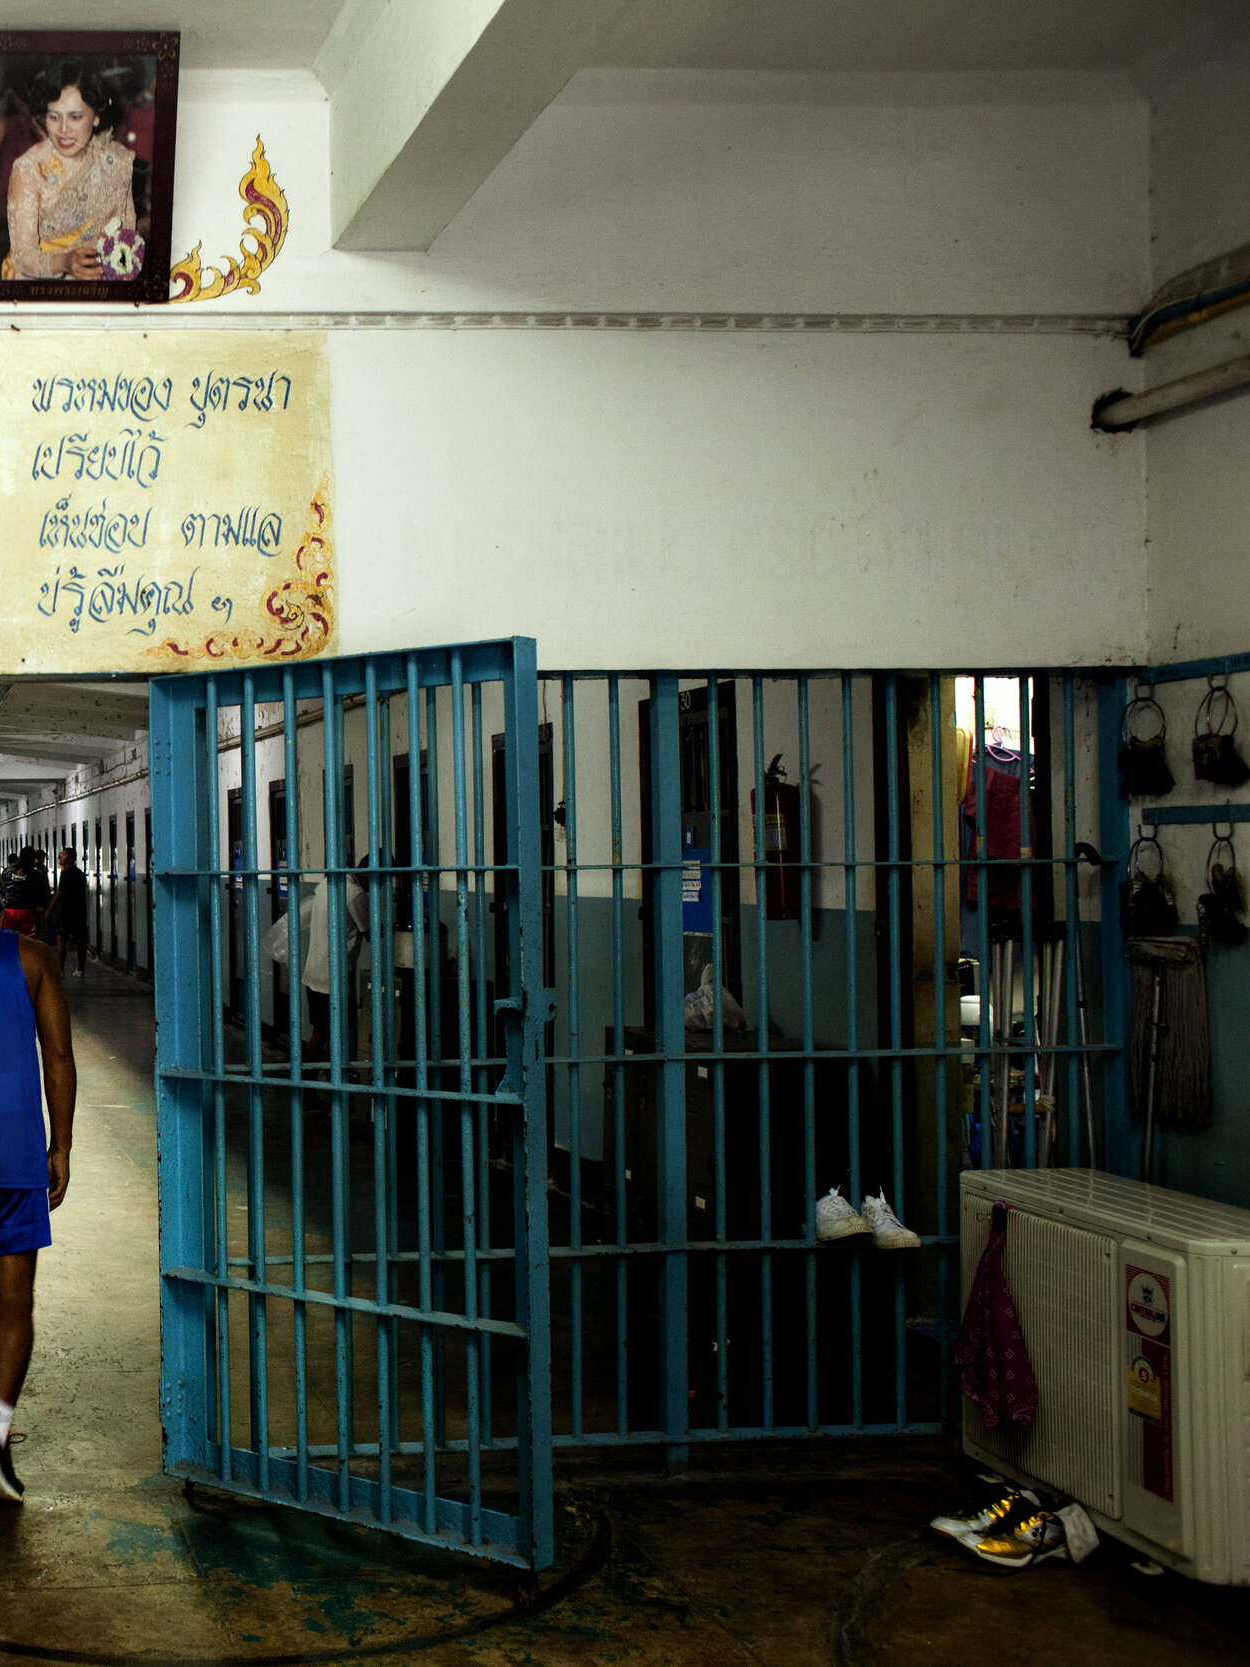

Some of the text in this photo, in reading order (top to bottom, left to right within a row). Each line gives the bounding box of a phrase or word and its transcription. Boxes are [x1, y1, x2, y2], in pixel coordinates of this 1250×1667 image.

[30, 282, 110, 299] ทรงพระเจริญ
[31, 372, 173, 422] พรหมของ
[184, 369, 291, 429] บุตรนา
[31, 428, 169, 489] เปรียบไว้
[181, 505, 284, 556] ตามแล
[680, 691, 691, 711] 30
